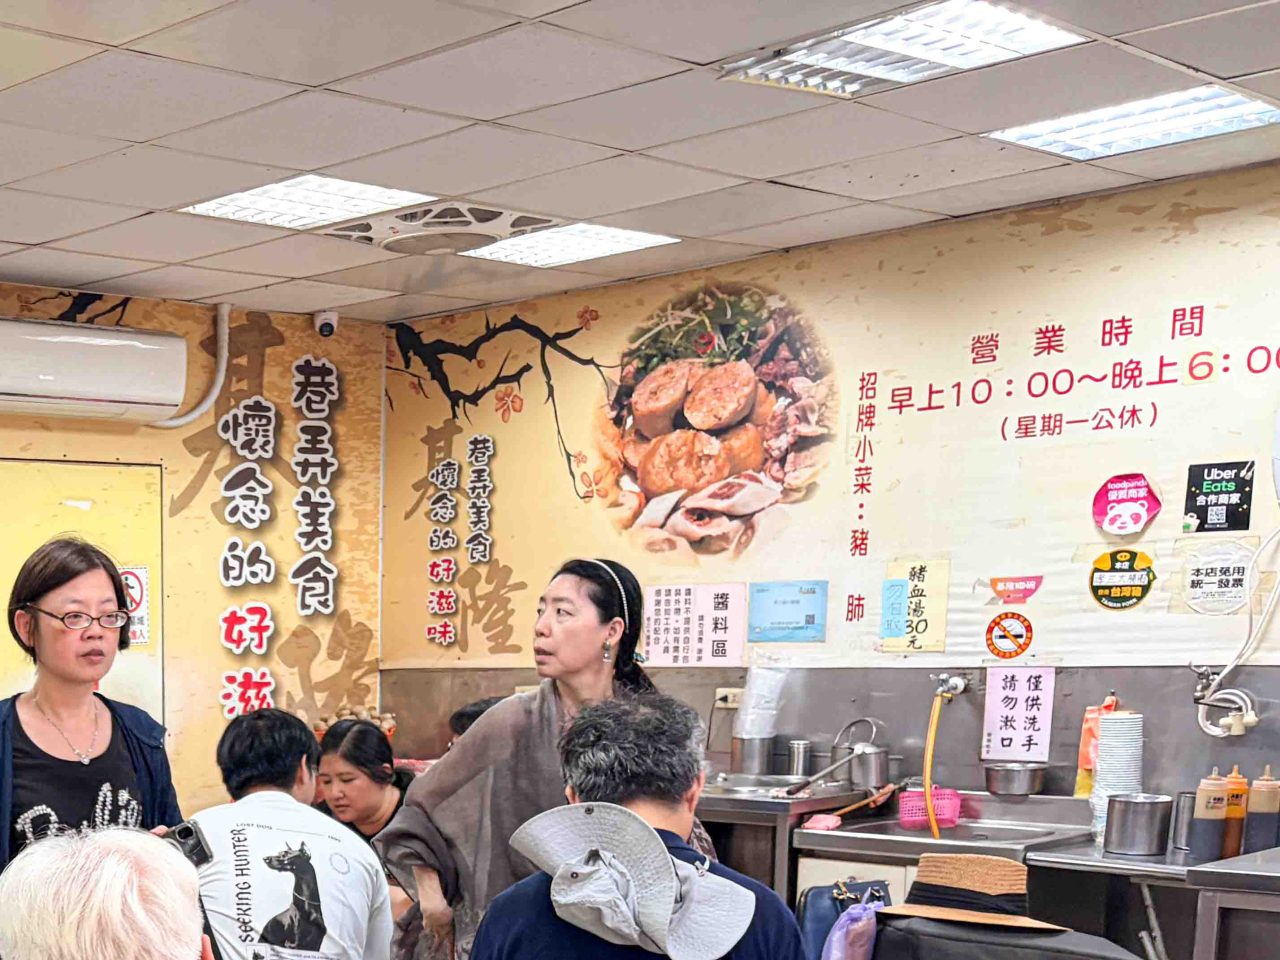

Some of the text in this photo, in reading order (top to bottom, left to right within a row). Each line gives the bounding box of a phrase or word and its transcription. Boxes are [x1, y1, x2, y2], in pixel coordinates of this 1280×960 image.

[970, 305, 1204, 365] 營業時間
[289, 355, 338, 615] 巷弄美食
[465, 435, 494, 563] 巷弄美食
[1196, 493, 1241, 506] 合作商家
[1202, 480, 1237, 493] Eats
[1203, 468, 1238, 480] Uber
[426, 460, 461, 646] 懷念的好滋味
[1190, 578, 1245, 590] 統一發票
[1191, 566, 1246, 578] 本店免用
[712, 592, 730, 658] 醬料區
[905, 565, 928, 650] 豬血湯30元
[1000, 674, 1019, 748] 請勿漱口
[1021, 674, 1043, 752] 僅供洗手
